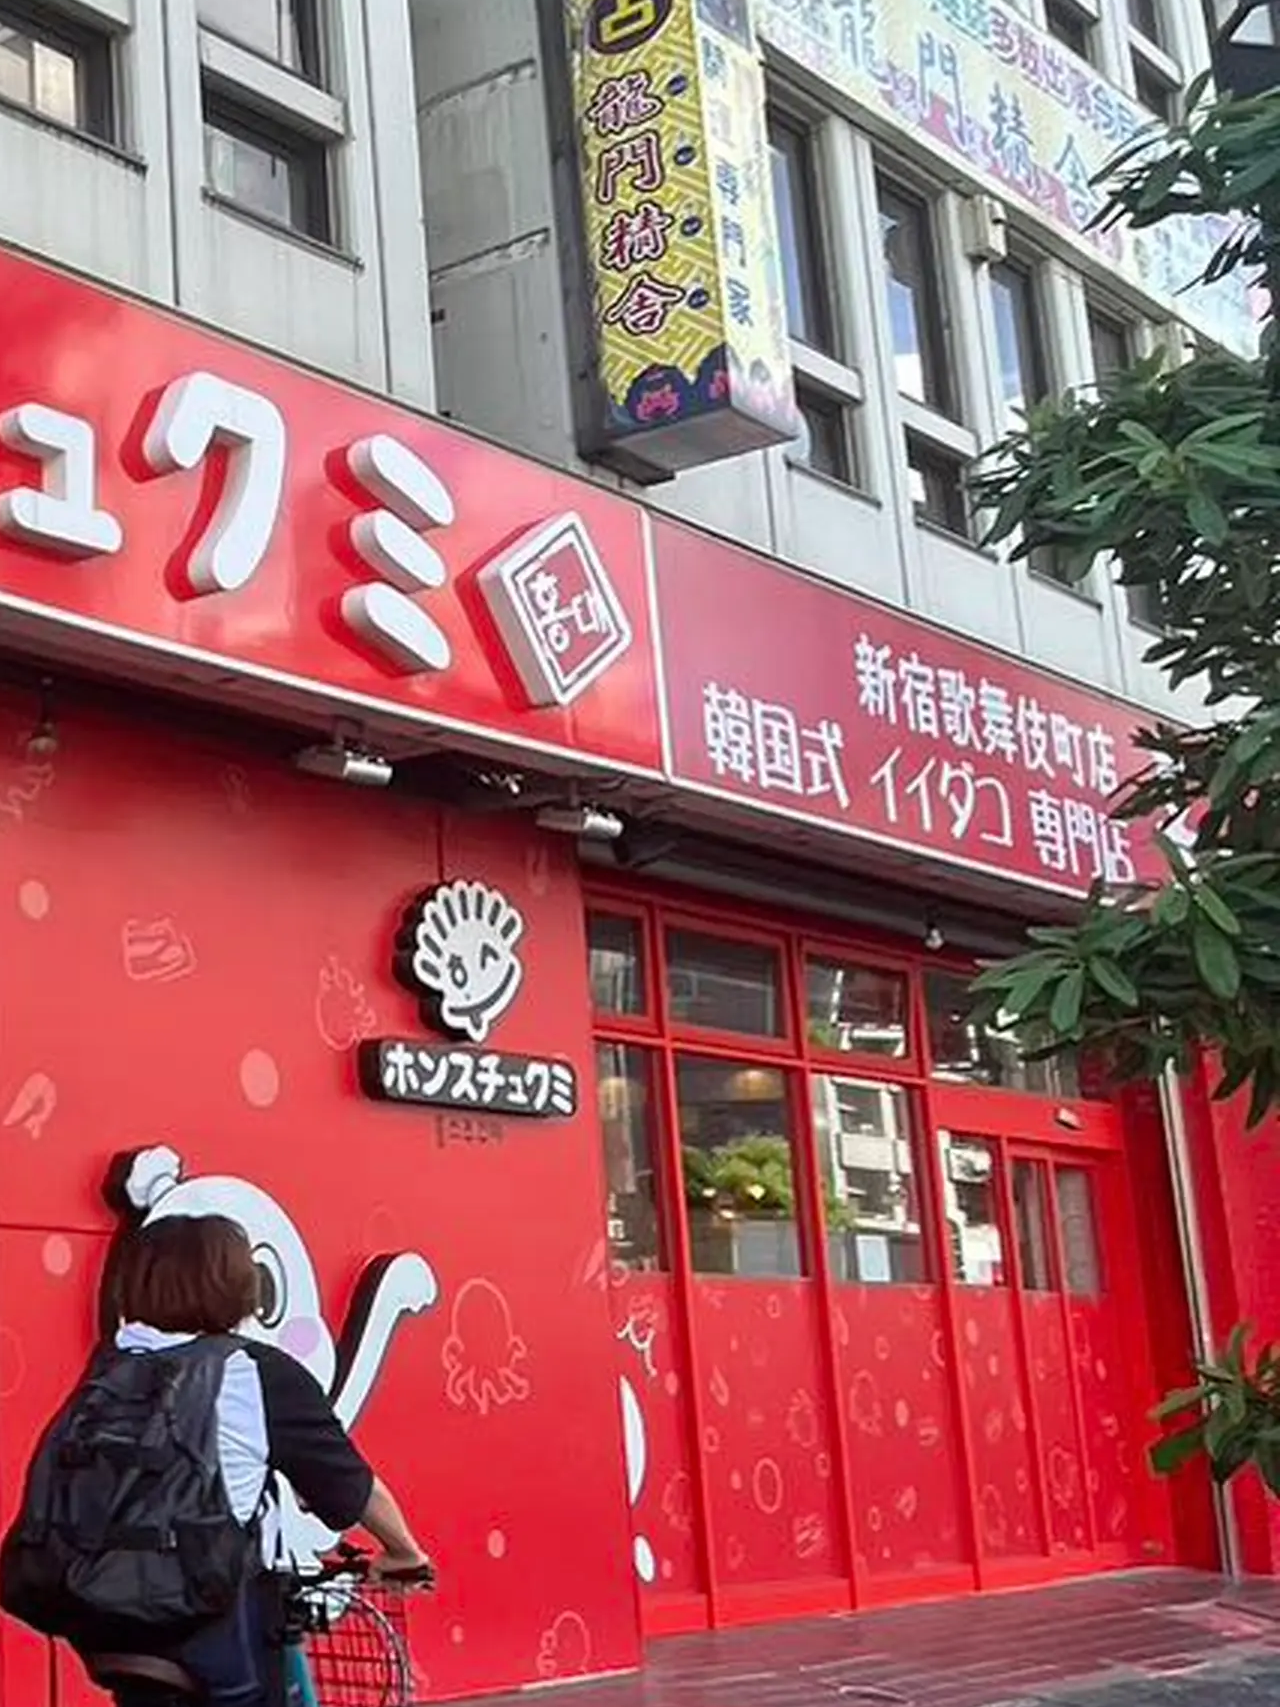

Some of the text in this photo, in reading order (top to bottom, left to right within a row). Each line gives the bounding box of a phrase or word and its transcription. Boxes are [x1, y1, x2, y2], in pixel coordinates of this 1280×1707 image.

[702, 681, 1137, 883] 韓国式 イイダコ 専門店
[851, 634, 1119, 796] 新宿歌舞伎町店
[383, 1042, 574, 1114] ホンスチュクミ
